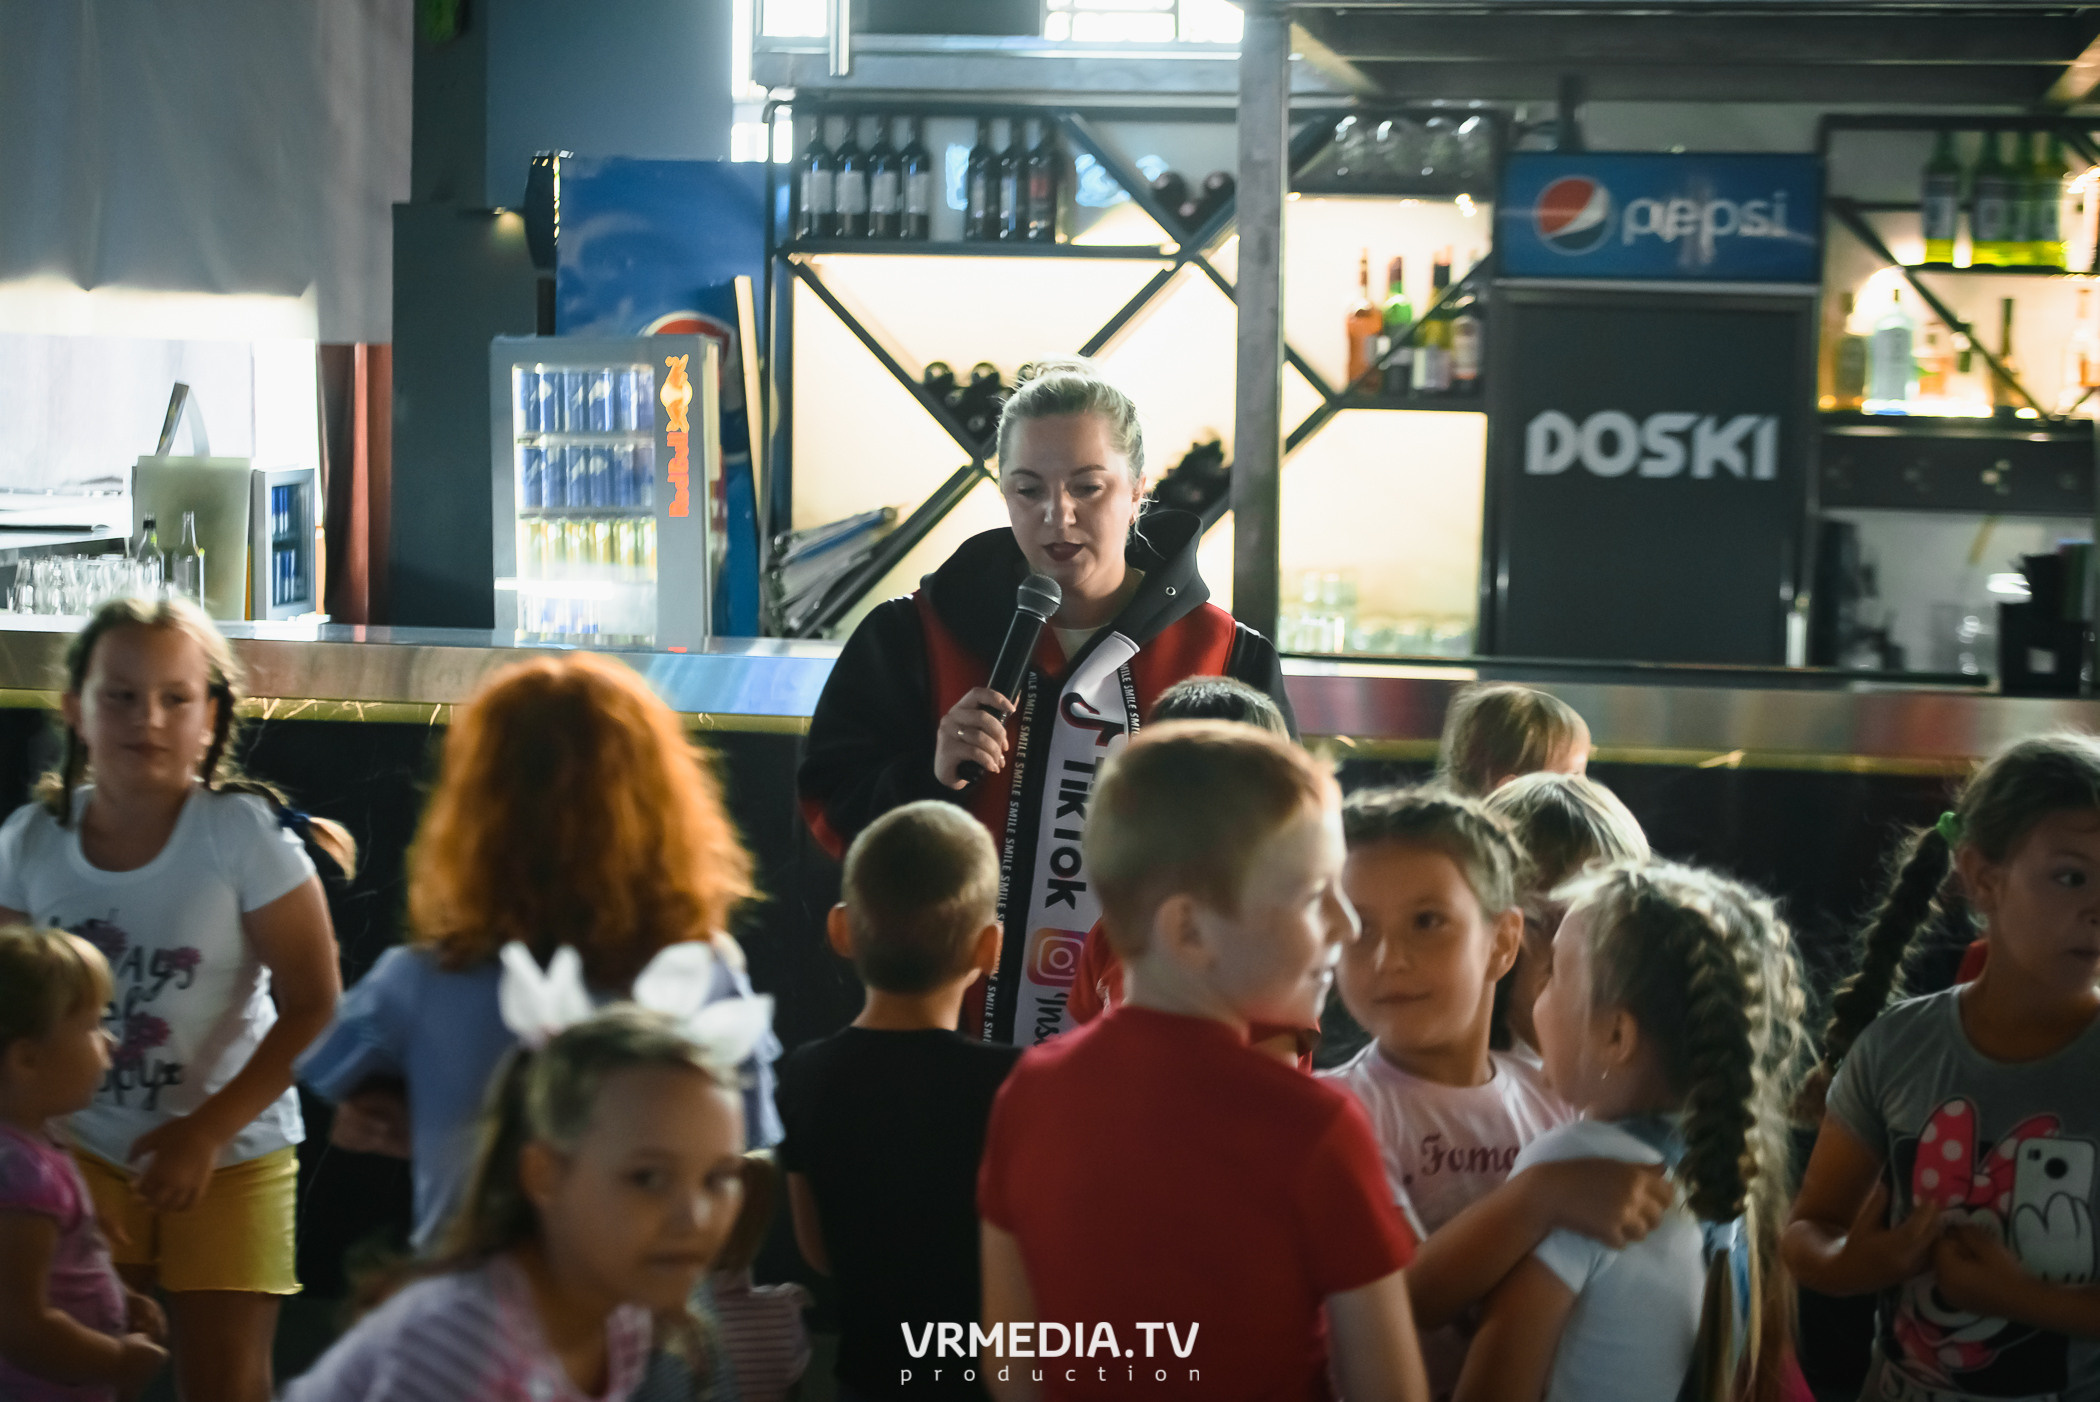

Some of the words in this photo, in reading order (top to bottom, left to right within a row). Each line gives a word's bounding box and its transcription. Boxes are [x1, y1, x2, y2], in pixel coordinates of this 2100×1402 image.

[1622, 189, 1789, 250] pepsi
[1524, 408, 1779, 480] DOSKI
[1023, 693, 1037, 722] SMILE
[1123, 685, 1137, 710] SMILE
[1016, 725, 1031, 758] SMILE
[1011, 762, 1025, 796] SMILE
[1006, 800, 1019, 834] SMILE
[1002, 837, 1015, 871] SMILE
[997, 874, 1010, 909] SMILE
[984, 984, 997, 1018] SMILE
